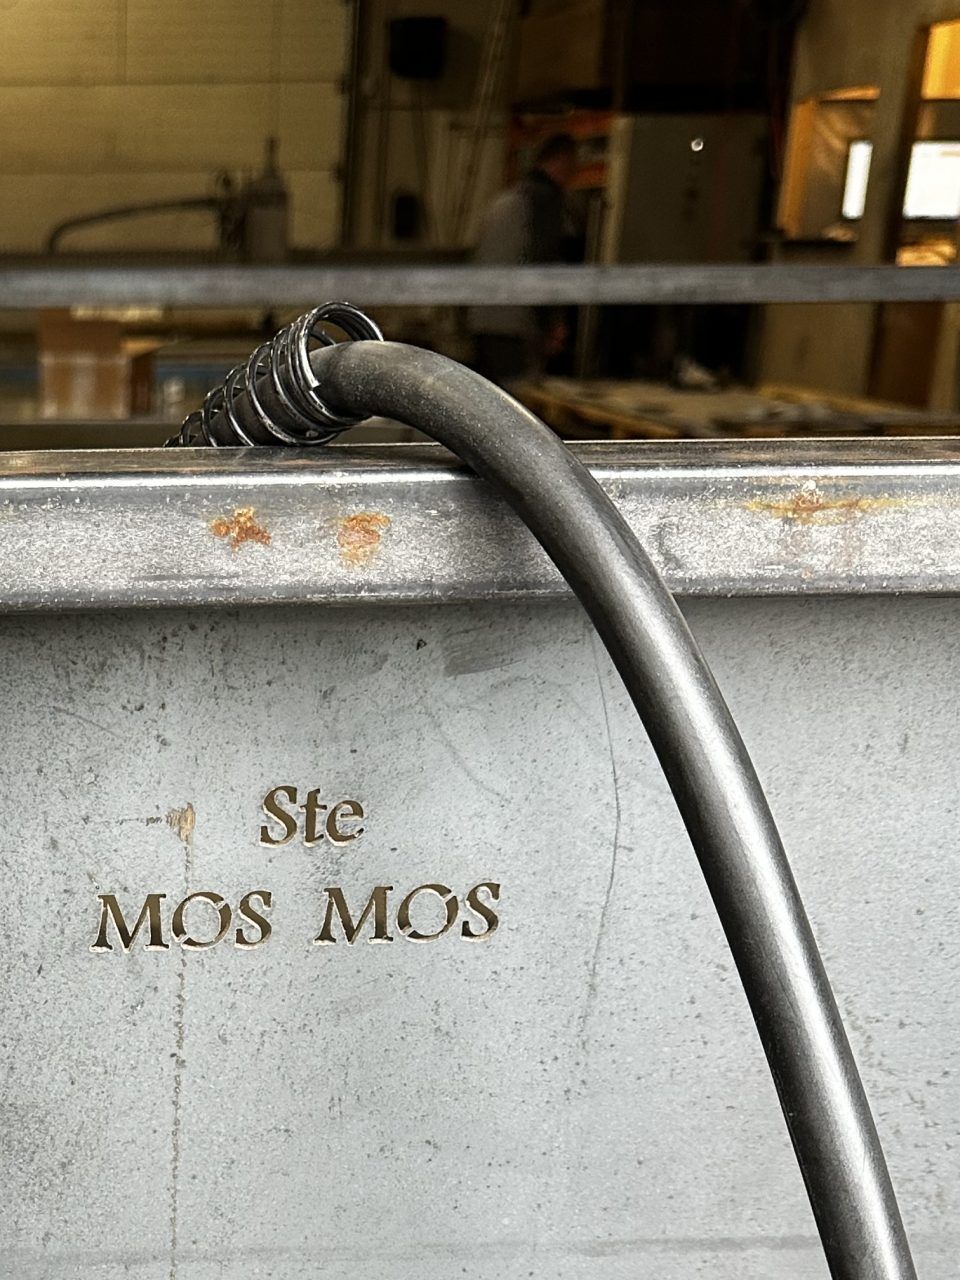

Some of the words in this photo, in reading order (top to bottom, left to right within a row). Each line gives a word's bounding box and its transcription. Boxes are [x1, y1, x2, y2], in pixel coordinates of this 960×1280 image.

[259, 785, 365, 848] Ste
[89, 889, 273, 953] MOS
[313, 881, 501, 946] MOS
